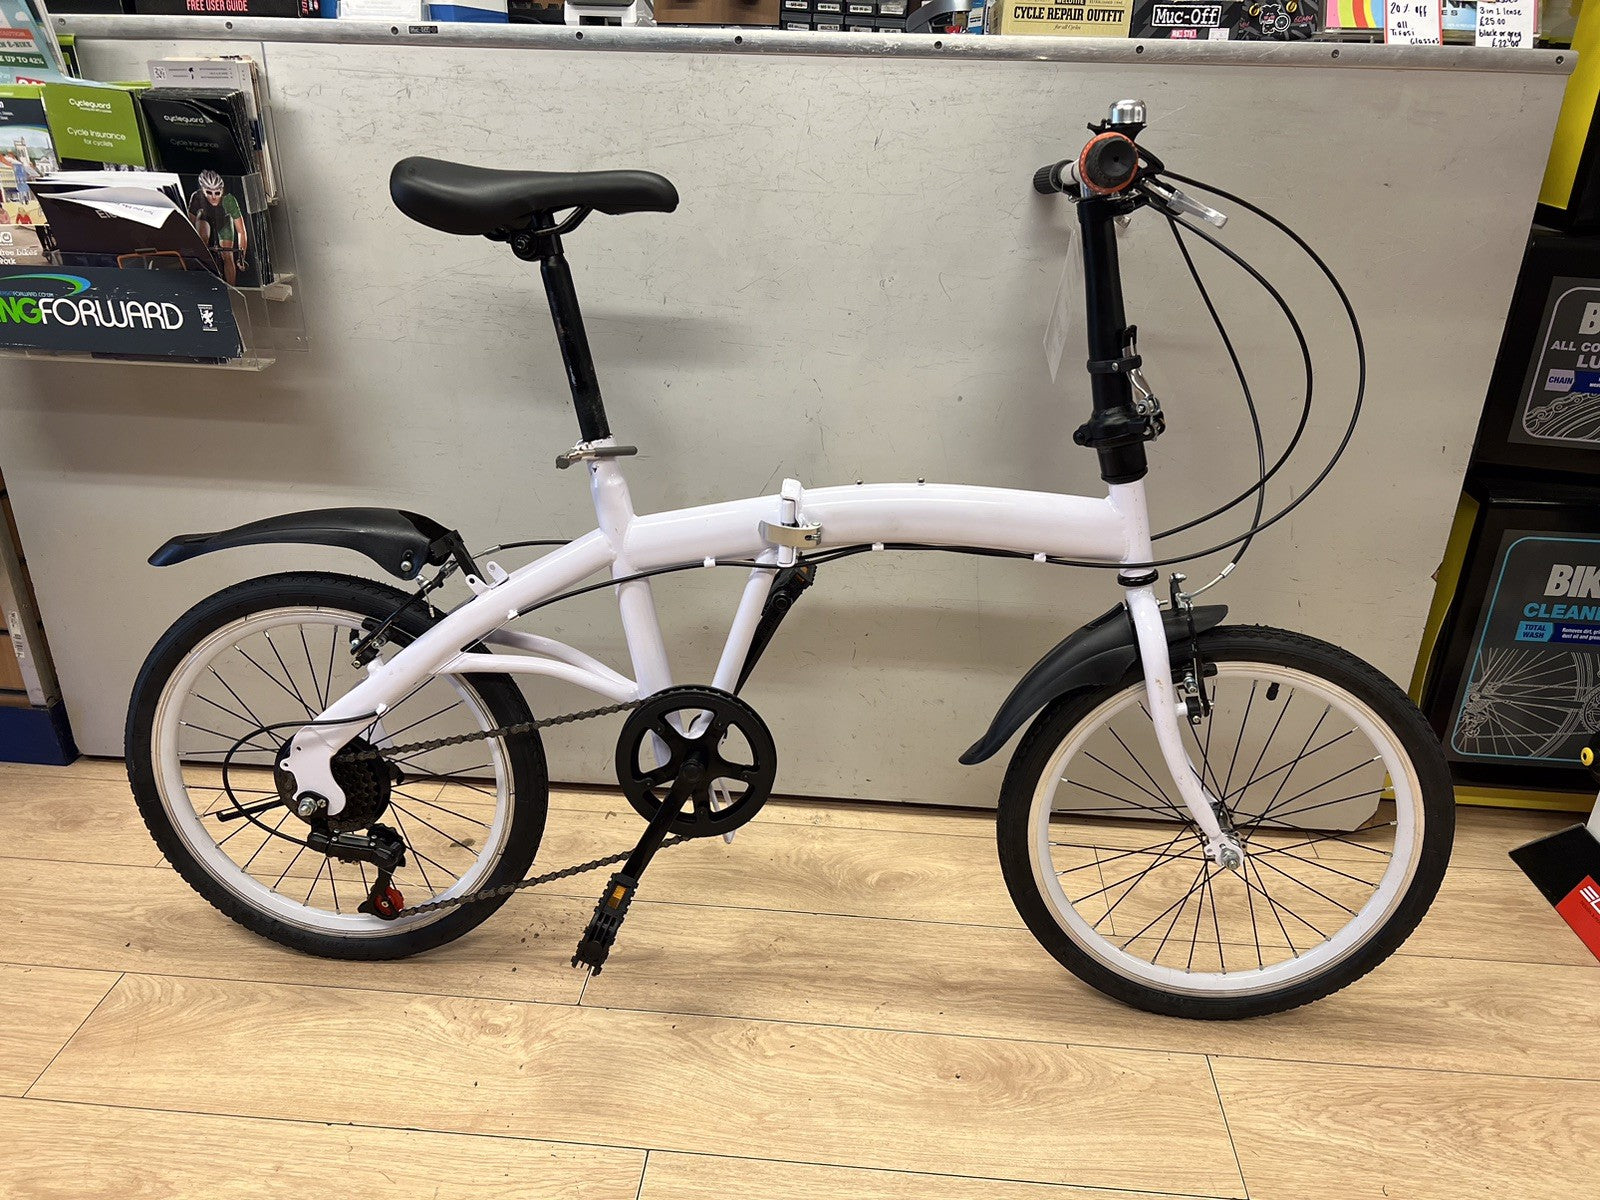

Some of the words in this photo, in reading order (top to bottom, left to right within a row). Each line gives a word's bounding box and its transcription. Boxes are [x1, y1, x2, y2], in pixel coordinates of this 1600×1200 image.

[187, 0, 205, 11] FREE
[206, 0, 225, 11] USER
[226, 0, 248, 12] GUIDE
[1415, 5, 1427, 17] off
[1014, 6, 1044, 19] CYCLE
[1047, 7, 1084, 21] REPAIR
[1087, 9, 1125, 22] OUTFIT
[1155, 8, 1218, 25] Muc-Off
[1479, 29, 1497, 37] black
[1507, 31, 1522, 42] grey
[67, 127, 89, 136] Cycle
[90, 130, 126, 141] Insurance
[1551, 340, 1577, 351] ALL
[1548, 376, 1574, 384] CHAIN
[1522, 631, 1545, 639] WASH
